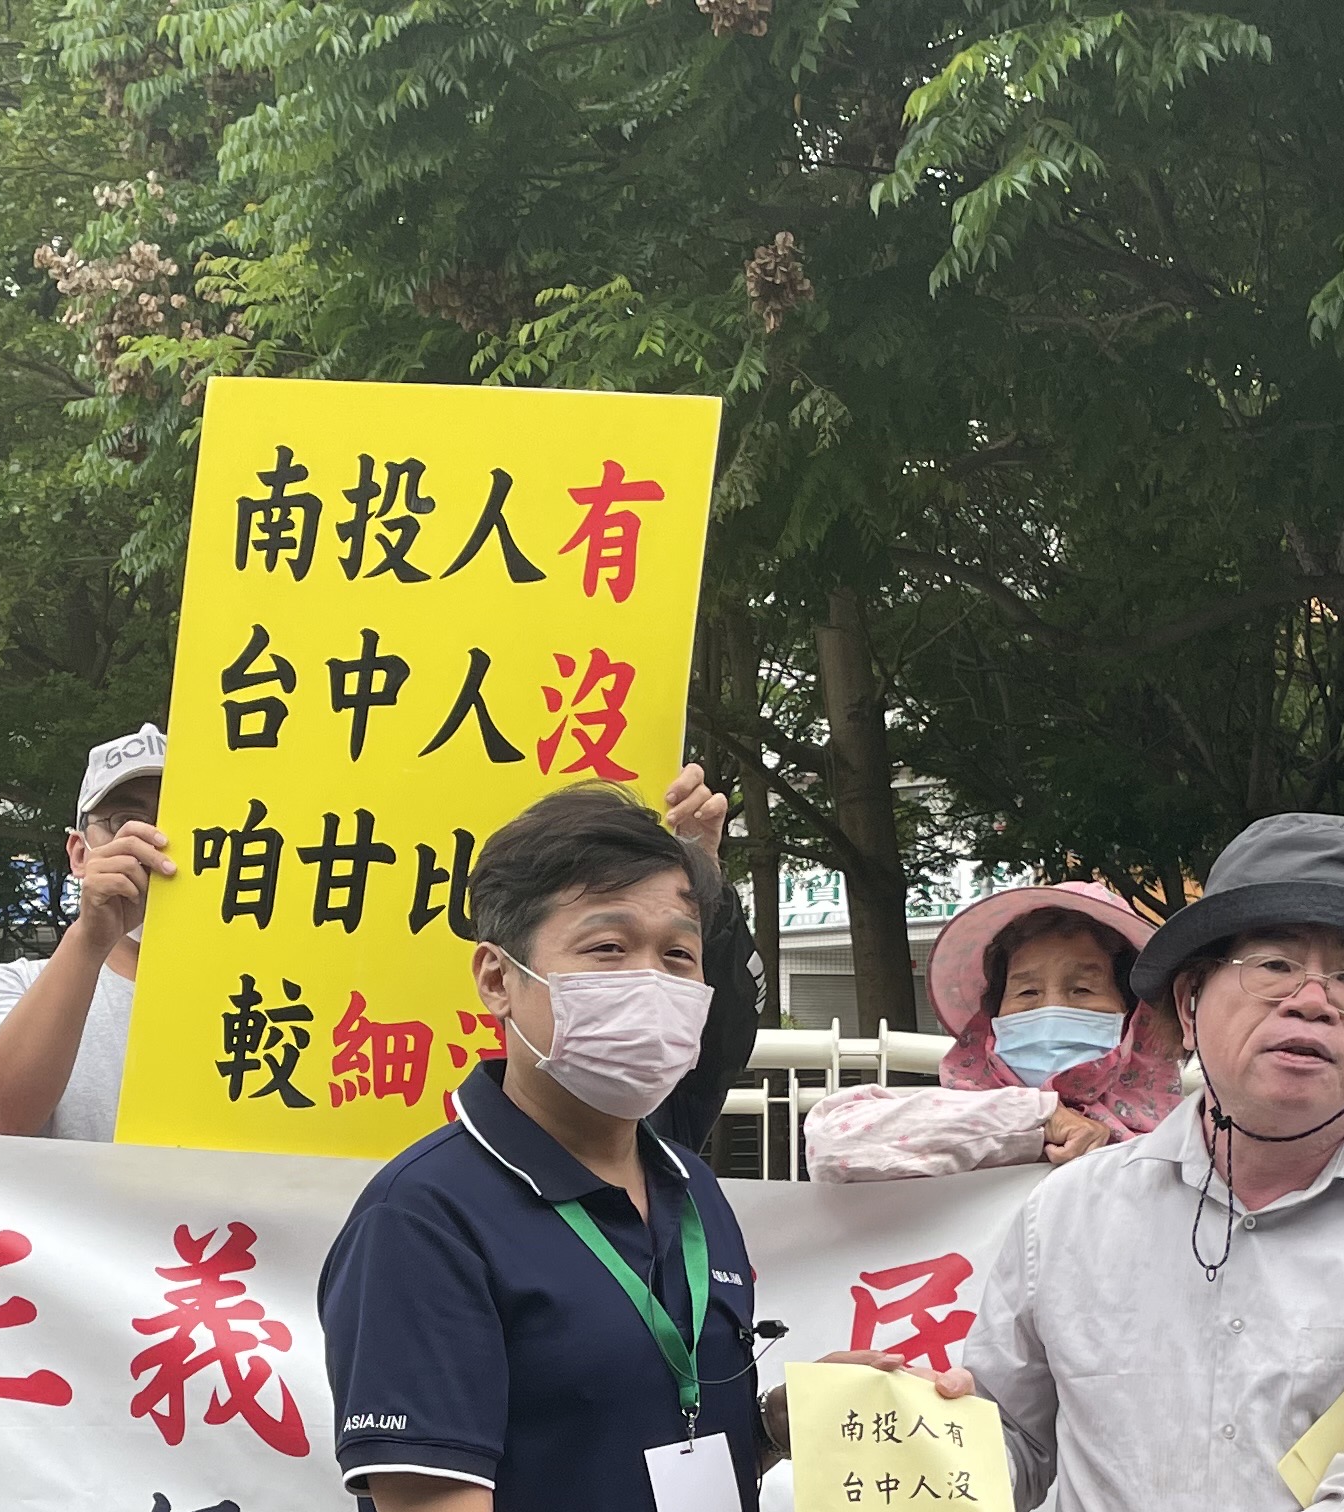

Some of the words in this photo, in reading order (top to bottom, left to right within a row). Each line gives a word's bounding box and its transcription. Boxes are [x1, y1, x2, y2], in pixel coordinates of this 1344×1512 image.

[234, 444, 666, 603] 南投人有
[220, 624, 640, 782] 台中人沒
[192, 798, 478, 943] 咱甘比
[850, 1252, 977, 1373] 民
[343, 1413, 407, 1433] ASIA.UNI
[840, 1409, 964, 1448] 南投人有
[842, 1471, 979, 1505] 台中人沒
